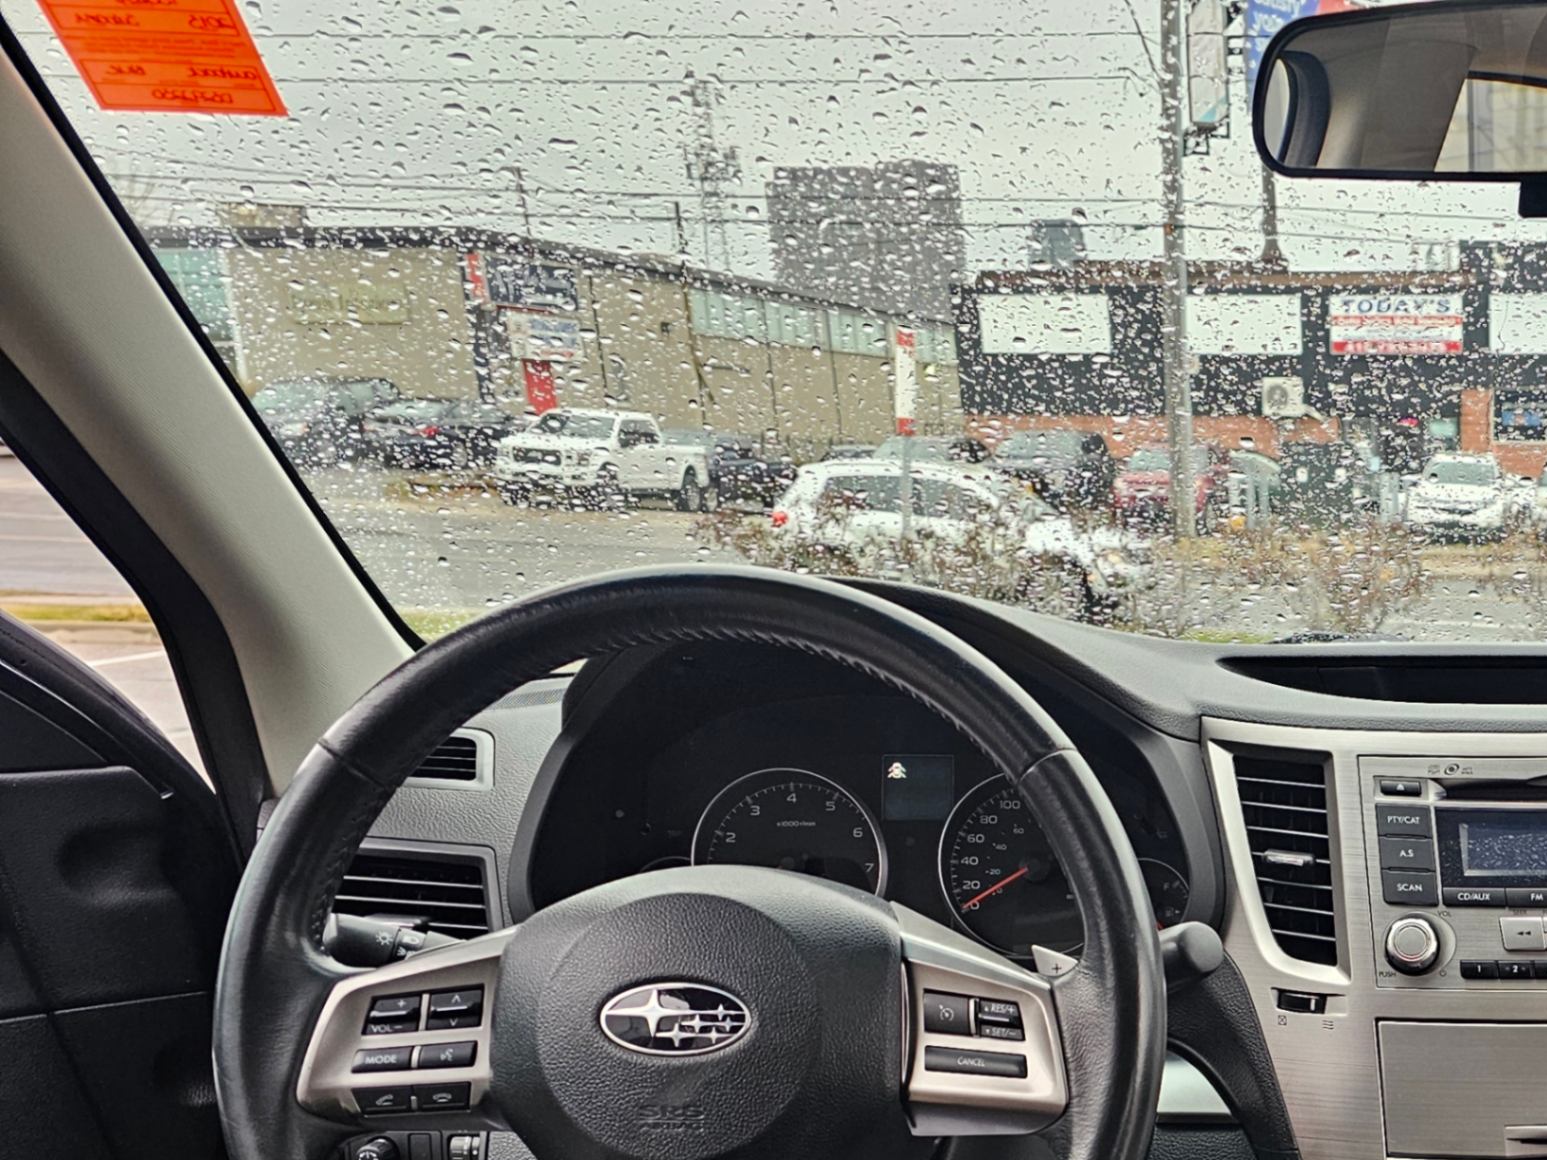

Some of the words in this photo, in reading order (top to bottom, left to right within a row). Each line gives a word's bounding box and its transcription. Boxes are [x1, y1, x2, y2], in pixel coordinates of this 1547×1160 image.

[1341, 299, 1451, 313] TODAY'S
[786, 793, 797, 803] 4
[825, 801, 836, 812] 5
[999, 799, 1021, 810] 100
[749, 805, 761, 816] 3
[980, 814, 998, 825] 80
[725, 832, 737, 843] 2
[853, 827, 863, 838] 6
[967, 834, 985, 844] 60
[961, 856, 979, 866] 40
[864, 862, 875, 873] 7
[962, 880, 981, 890] 20
[1397, 883, 1423, 892] SCAN
[1457, 892, 1491, 901] CD/AUX
[1530, 893, 1544, 901] FM
[1512, 965, 1519, 973] 2
[365, 1054, 397, 1065] MODE
[957, 1056, 986, 1067] CANCEL
